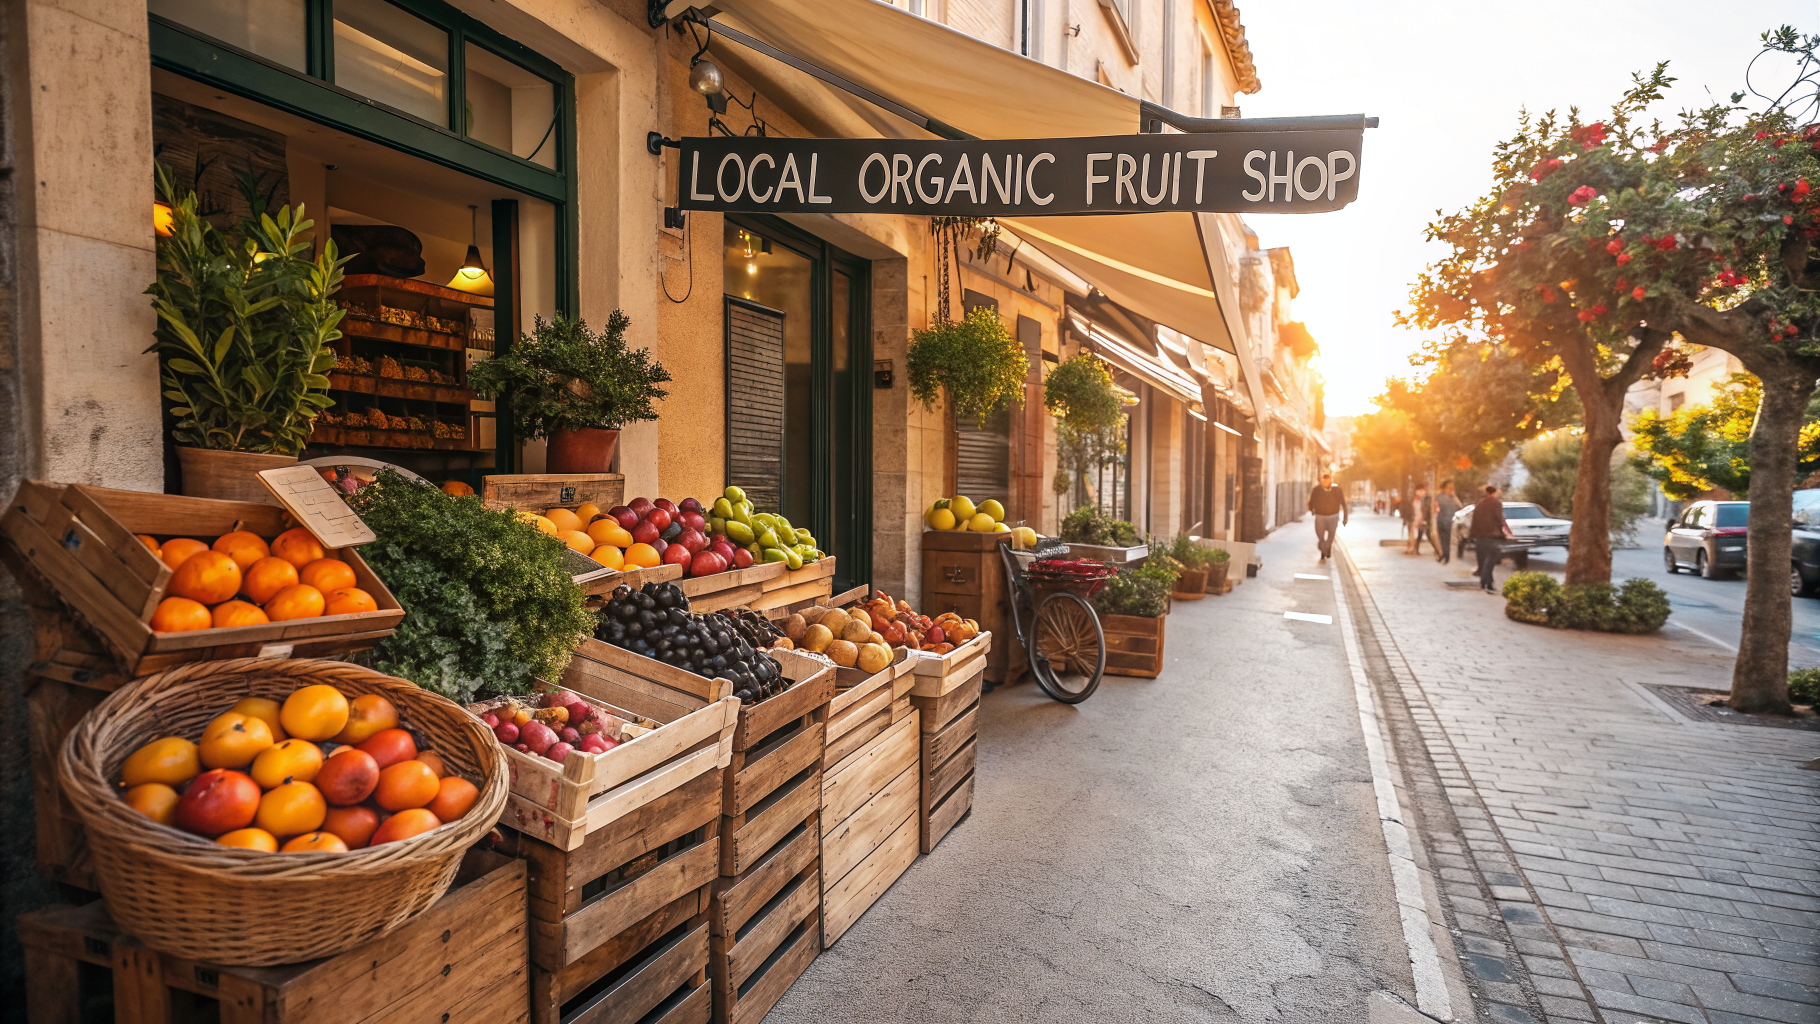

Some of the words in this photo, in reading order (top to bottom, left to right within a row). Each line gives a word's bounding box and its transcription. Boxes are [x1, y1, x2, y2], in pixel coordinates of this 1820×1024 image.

[690, 150, 833, 205] LOCAL
[858, 152, 1056, 206] ORGANIC
[1086, 150, 1218, 206] FRUIT
[1241, 149, 1357, 203] SHOP
